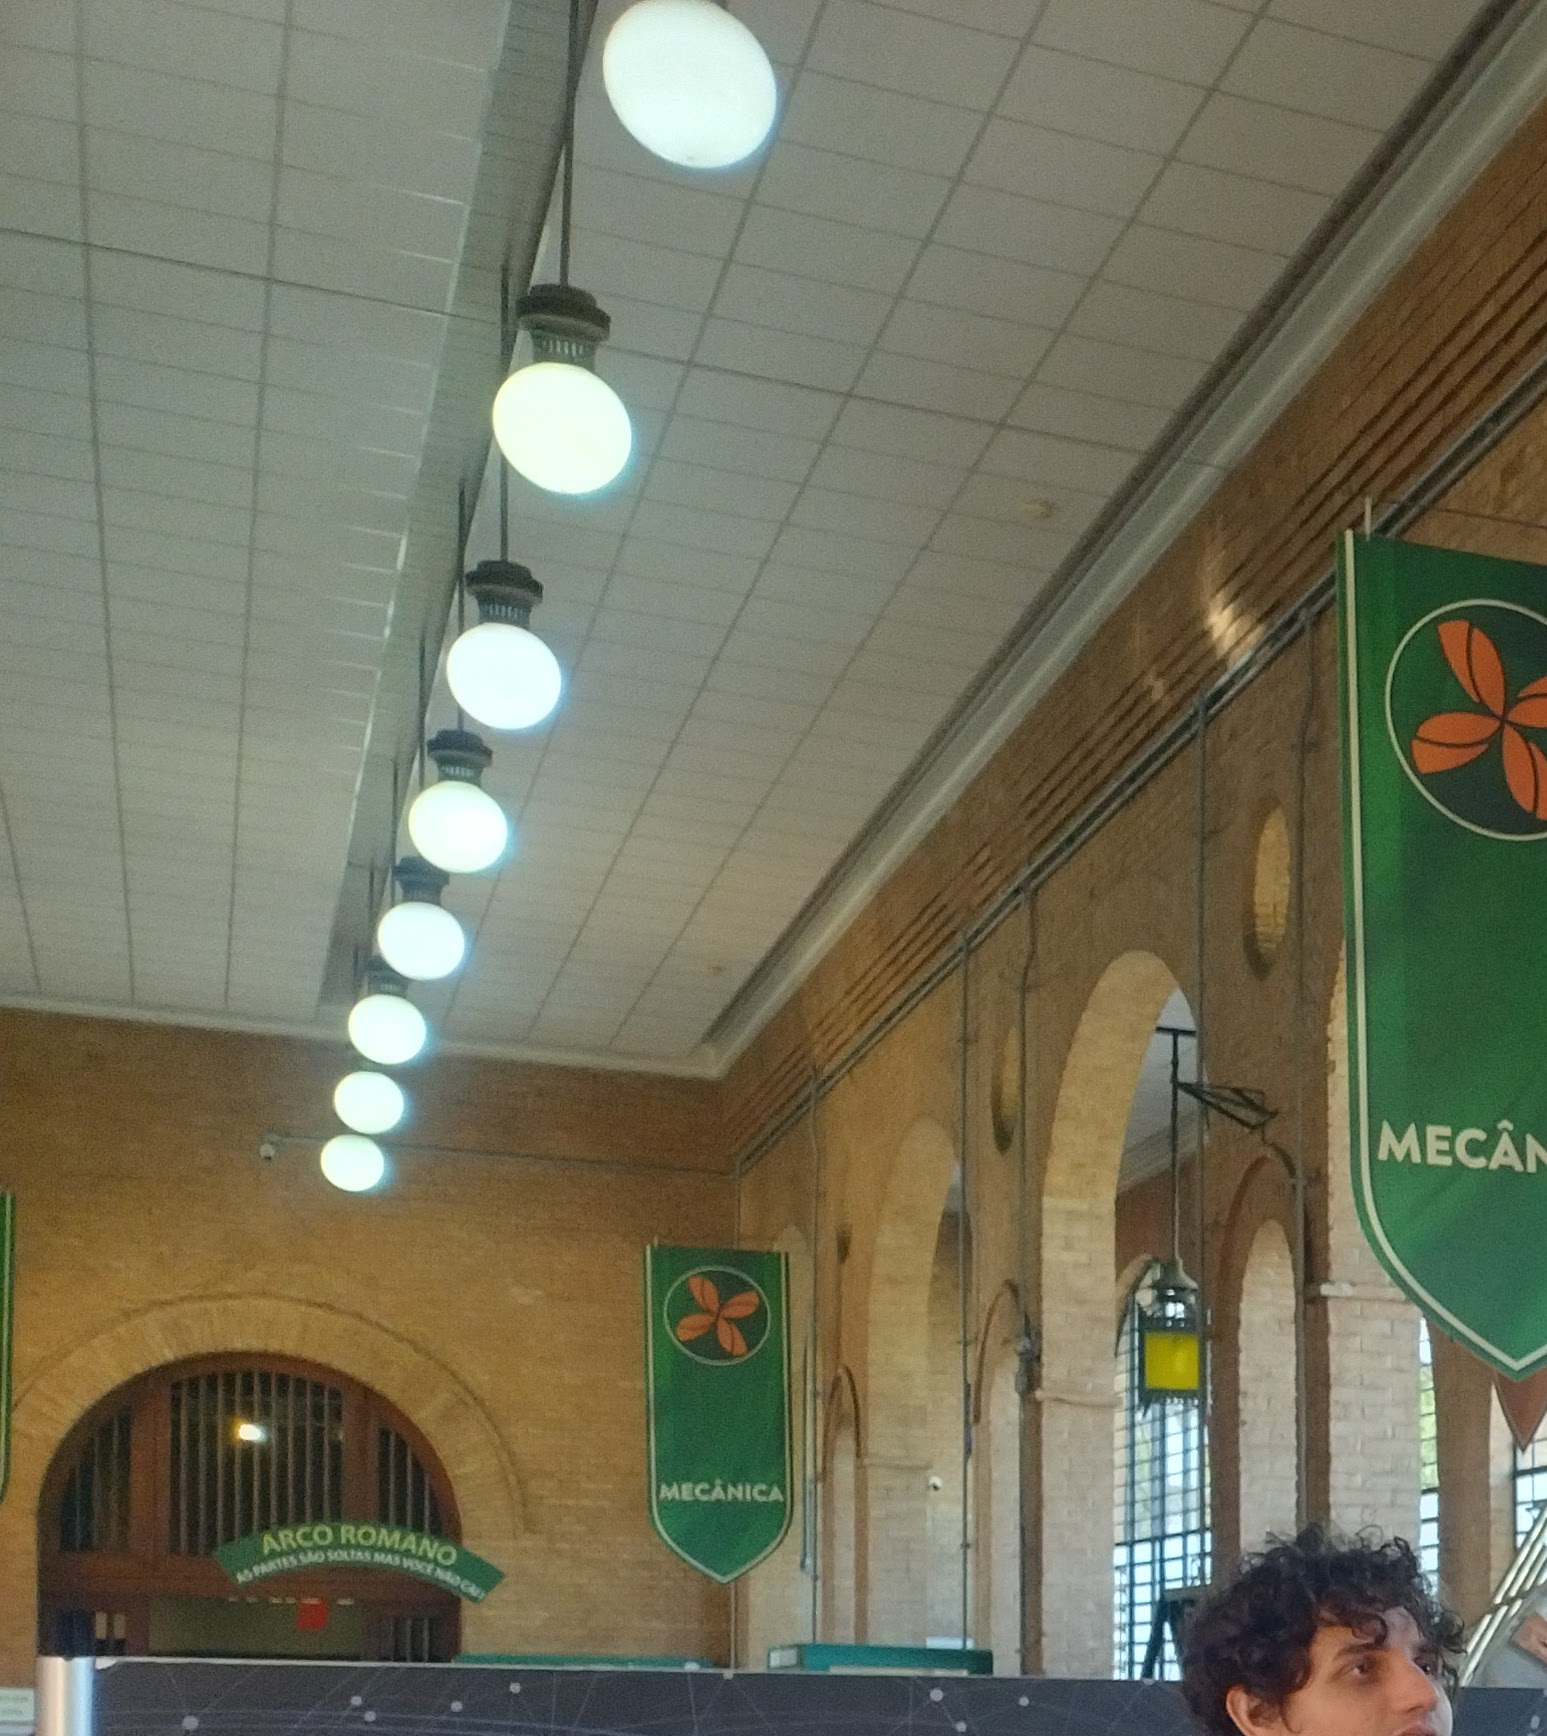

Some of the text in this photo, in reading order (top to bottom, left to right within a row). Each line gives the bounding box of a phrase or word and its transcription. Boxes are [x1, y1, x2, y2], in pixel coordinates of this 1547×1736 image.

[659, 1477, 785, 1502] MECÂNICA
[261, 1524, 457, 1566] ARCO ROMANO
